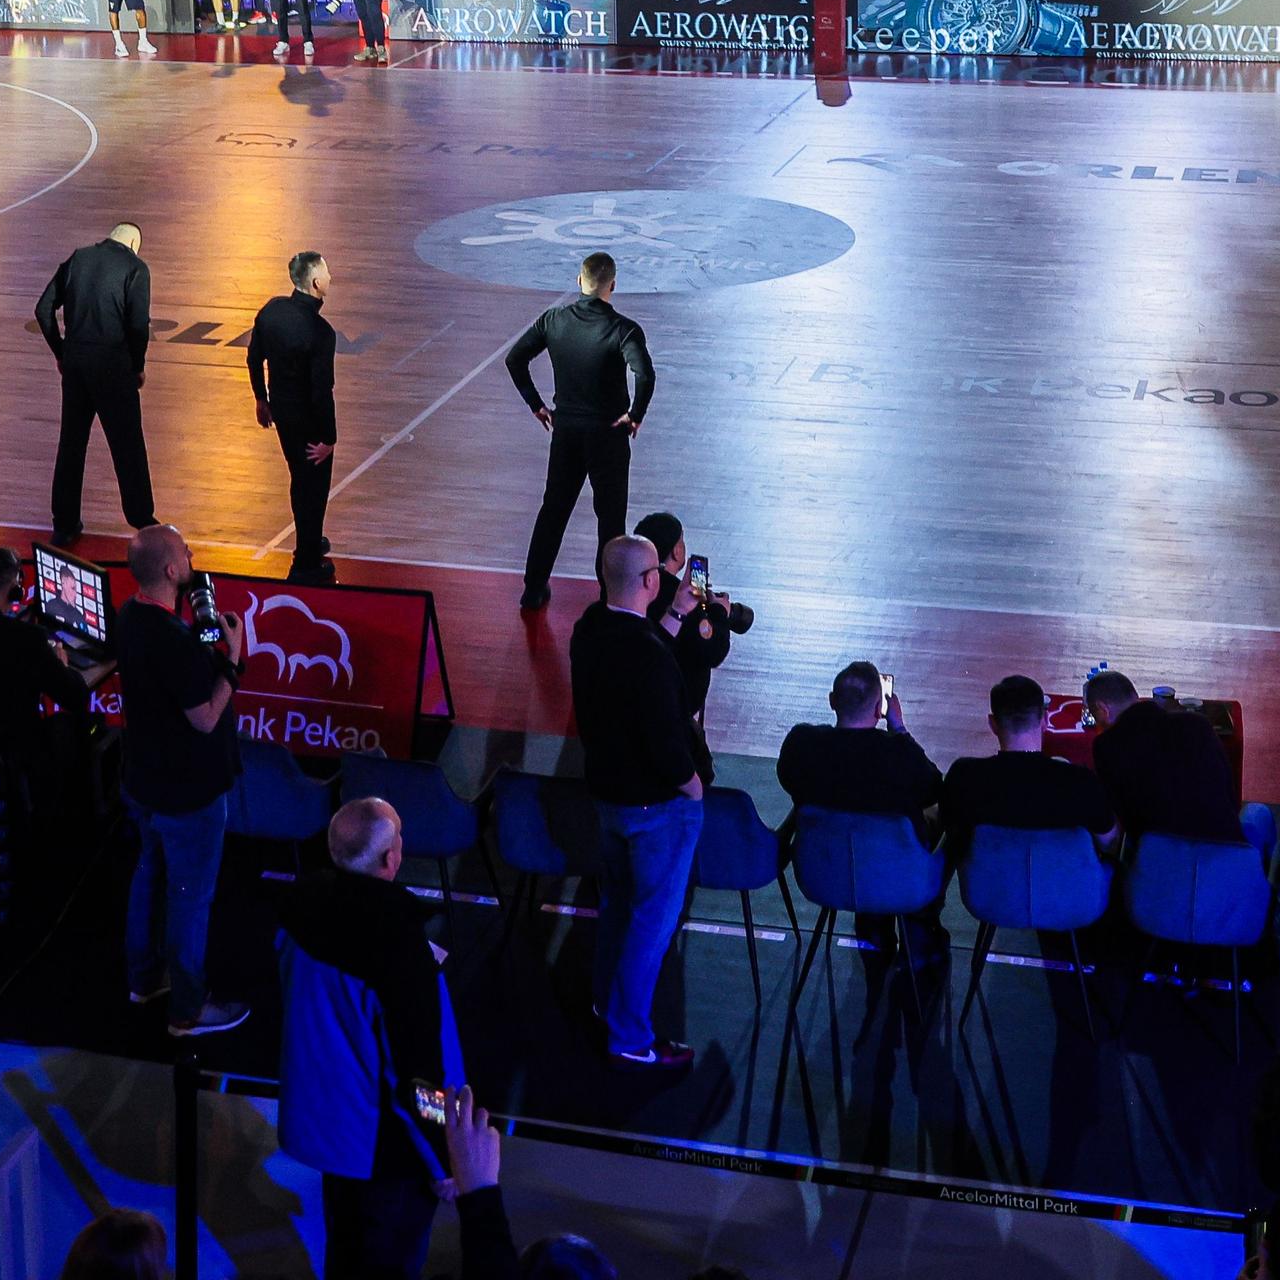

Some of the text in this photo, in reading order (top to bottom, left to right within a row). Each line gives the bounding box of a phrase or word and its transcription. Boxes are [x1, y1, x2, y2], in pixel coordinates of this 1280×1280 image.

[414, 8, 608, 36] AEROWATCH
[630, 11, 816, 40] AEROWATC
[285, 710, 380, 753] Pekao
[939, 1185, 1078, 1216] ArcelorMittal Park
